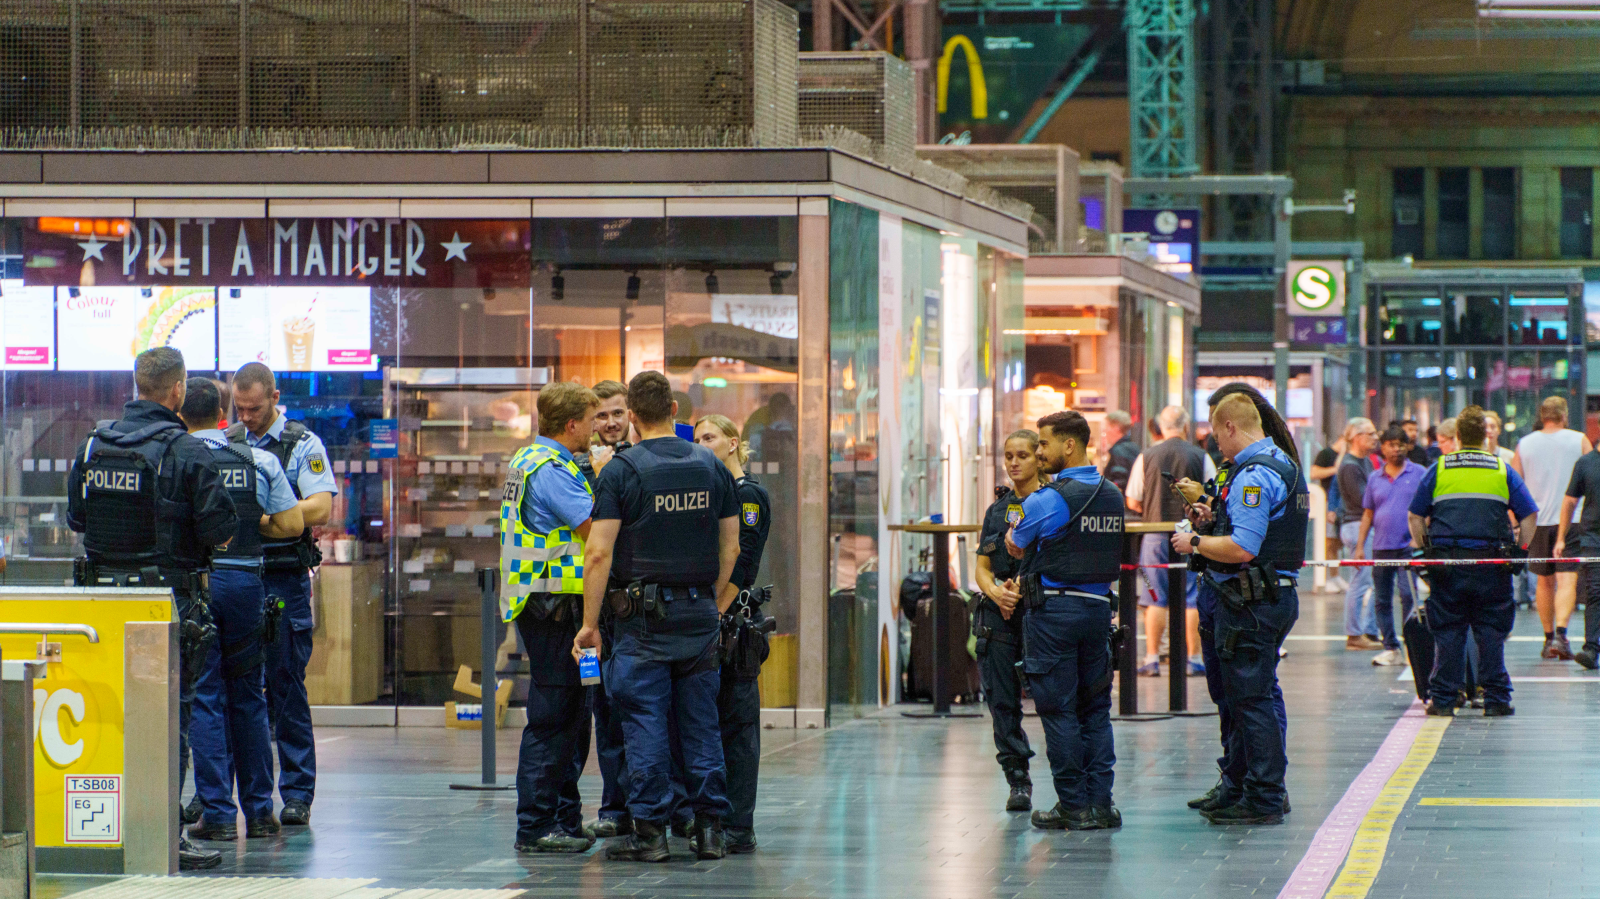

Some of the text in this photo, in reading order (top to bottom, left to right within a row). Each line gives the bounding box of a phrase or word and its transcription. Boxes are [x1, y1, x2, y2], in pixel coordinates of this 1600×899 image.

[122, 218, 427, 276] PRET A MANGER
[1296, 267, 1330, 308] S
[66, 295, 118, 311] Colour
[93, 309, 111, 318] full
[1458, 452, 1498, 462] Sicherheit
[86, 469, 140, 491] POLIZEI
[655, 490, 710, 513] POLIZEI
[1080, 515, 1122, 533] POLIZEI
[71, 779, 115, 790] T-SB08
[74, 799, 91, 809] EG
[101, 824, 111, 834] -1
